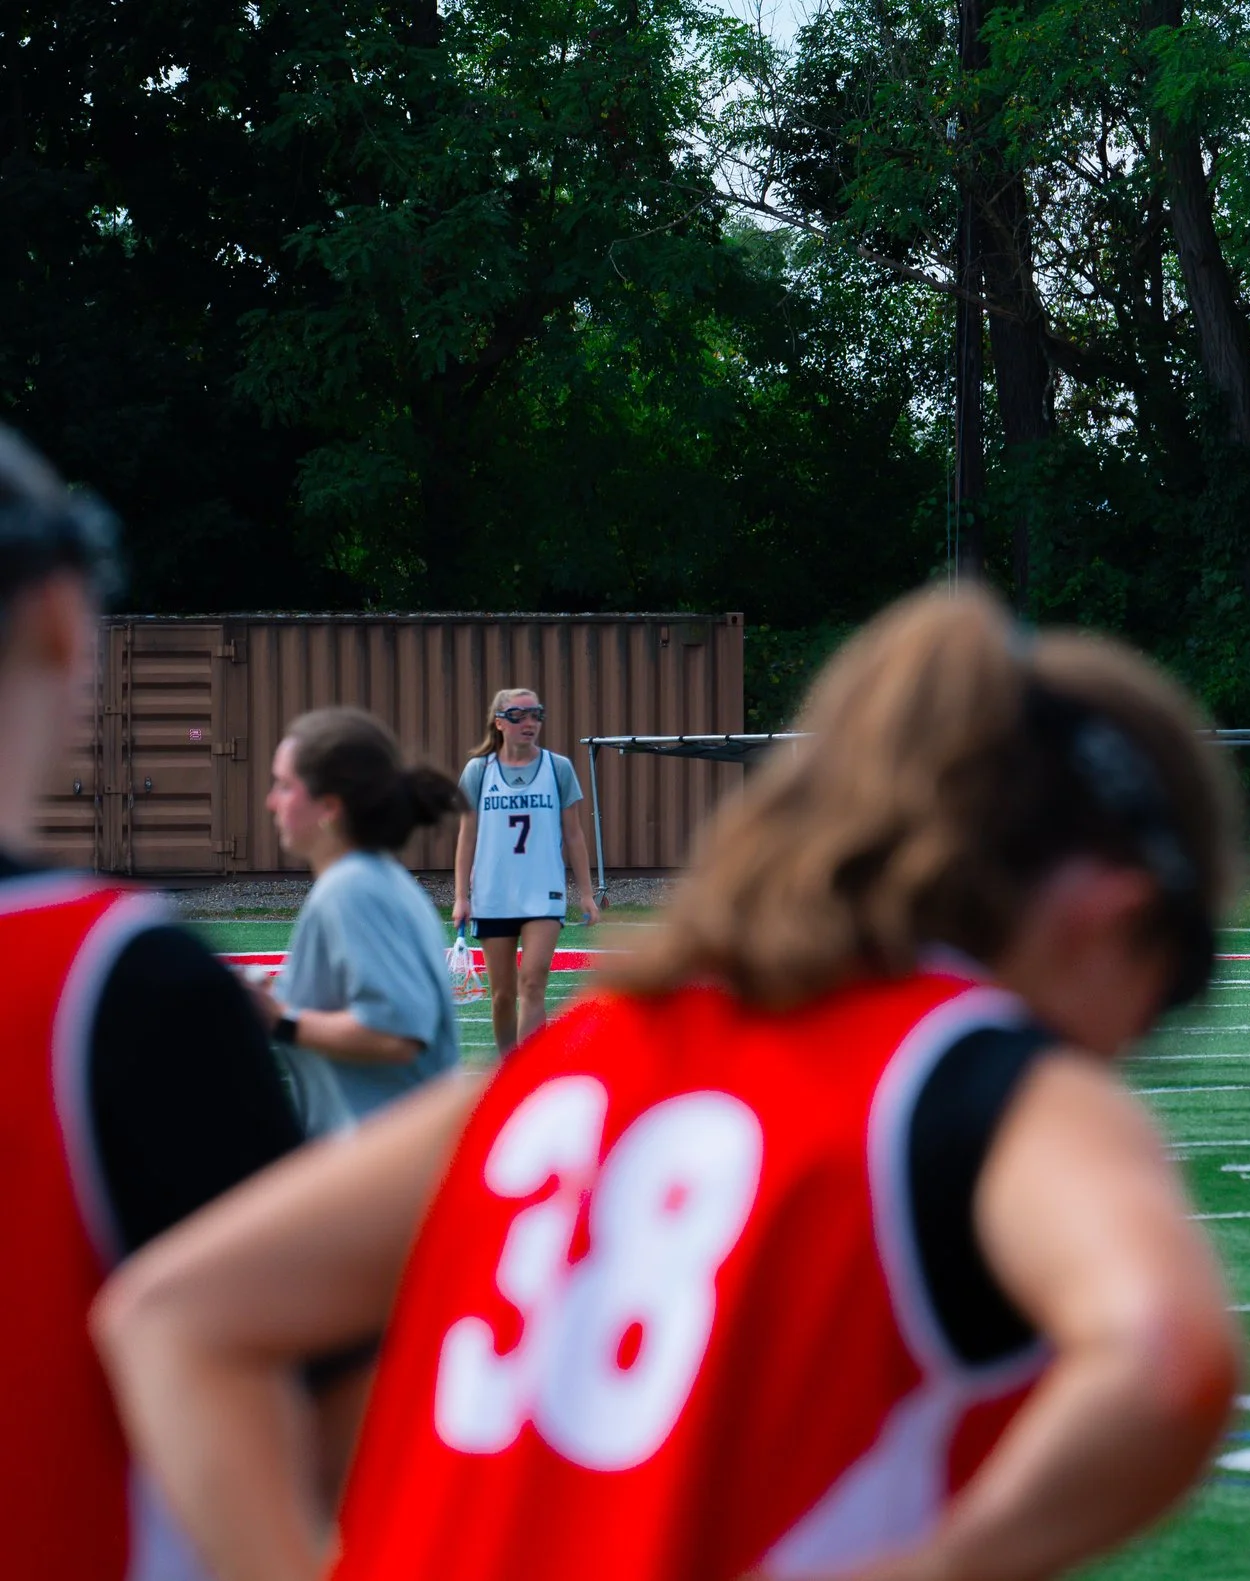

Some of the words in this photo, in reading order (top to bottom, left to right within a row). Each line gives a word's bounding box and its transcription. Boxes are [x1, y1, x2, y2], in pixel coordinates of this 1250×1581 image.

[484, 794, 553, 811] BUCKNELL
[508, 814, 530, 855] 7
[434, 1074, 764, 1472] 38
